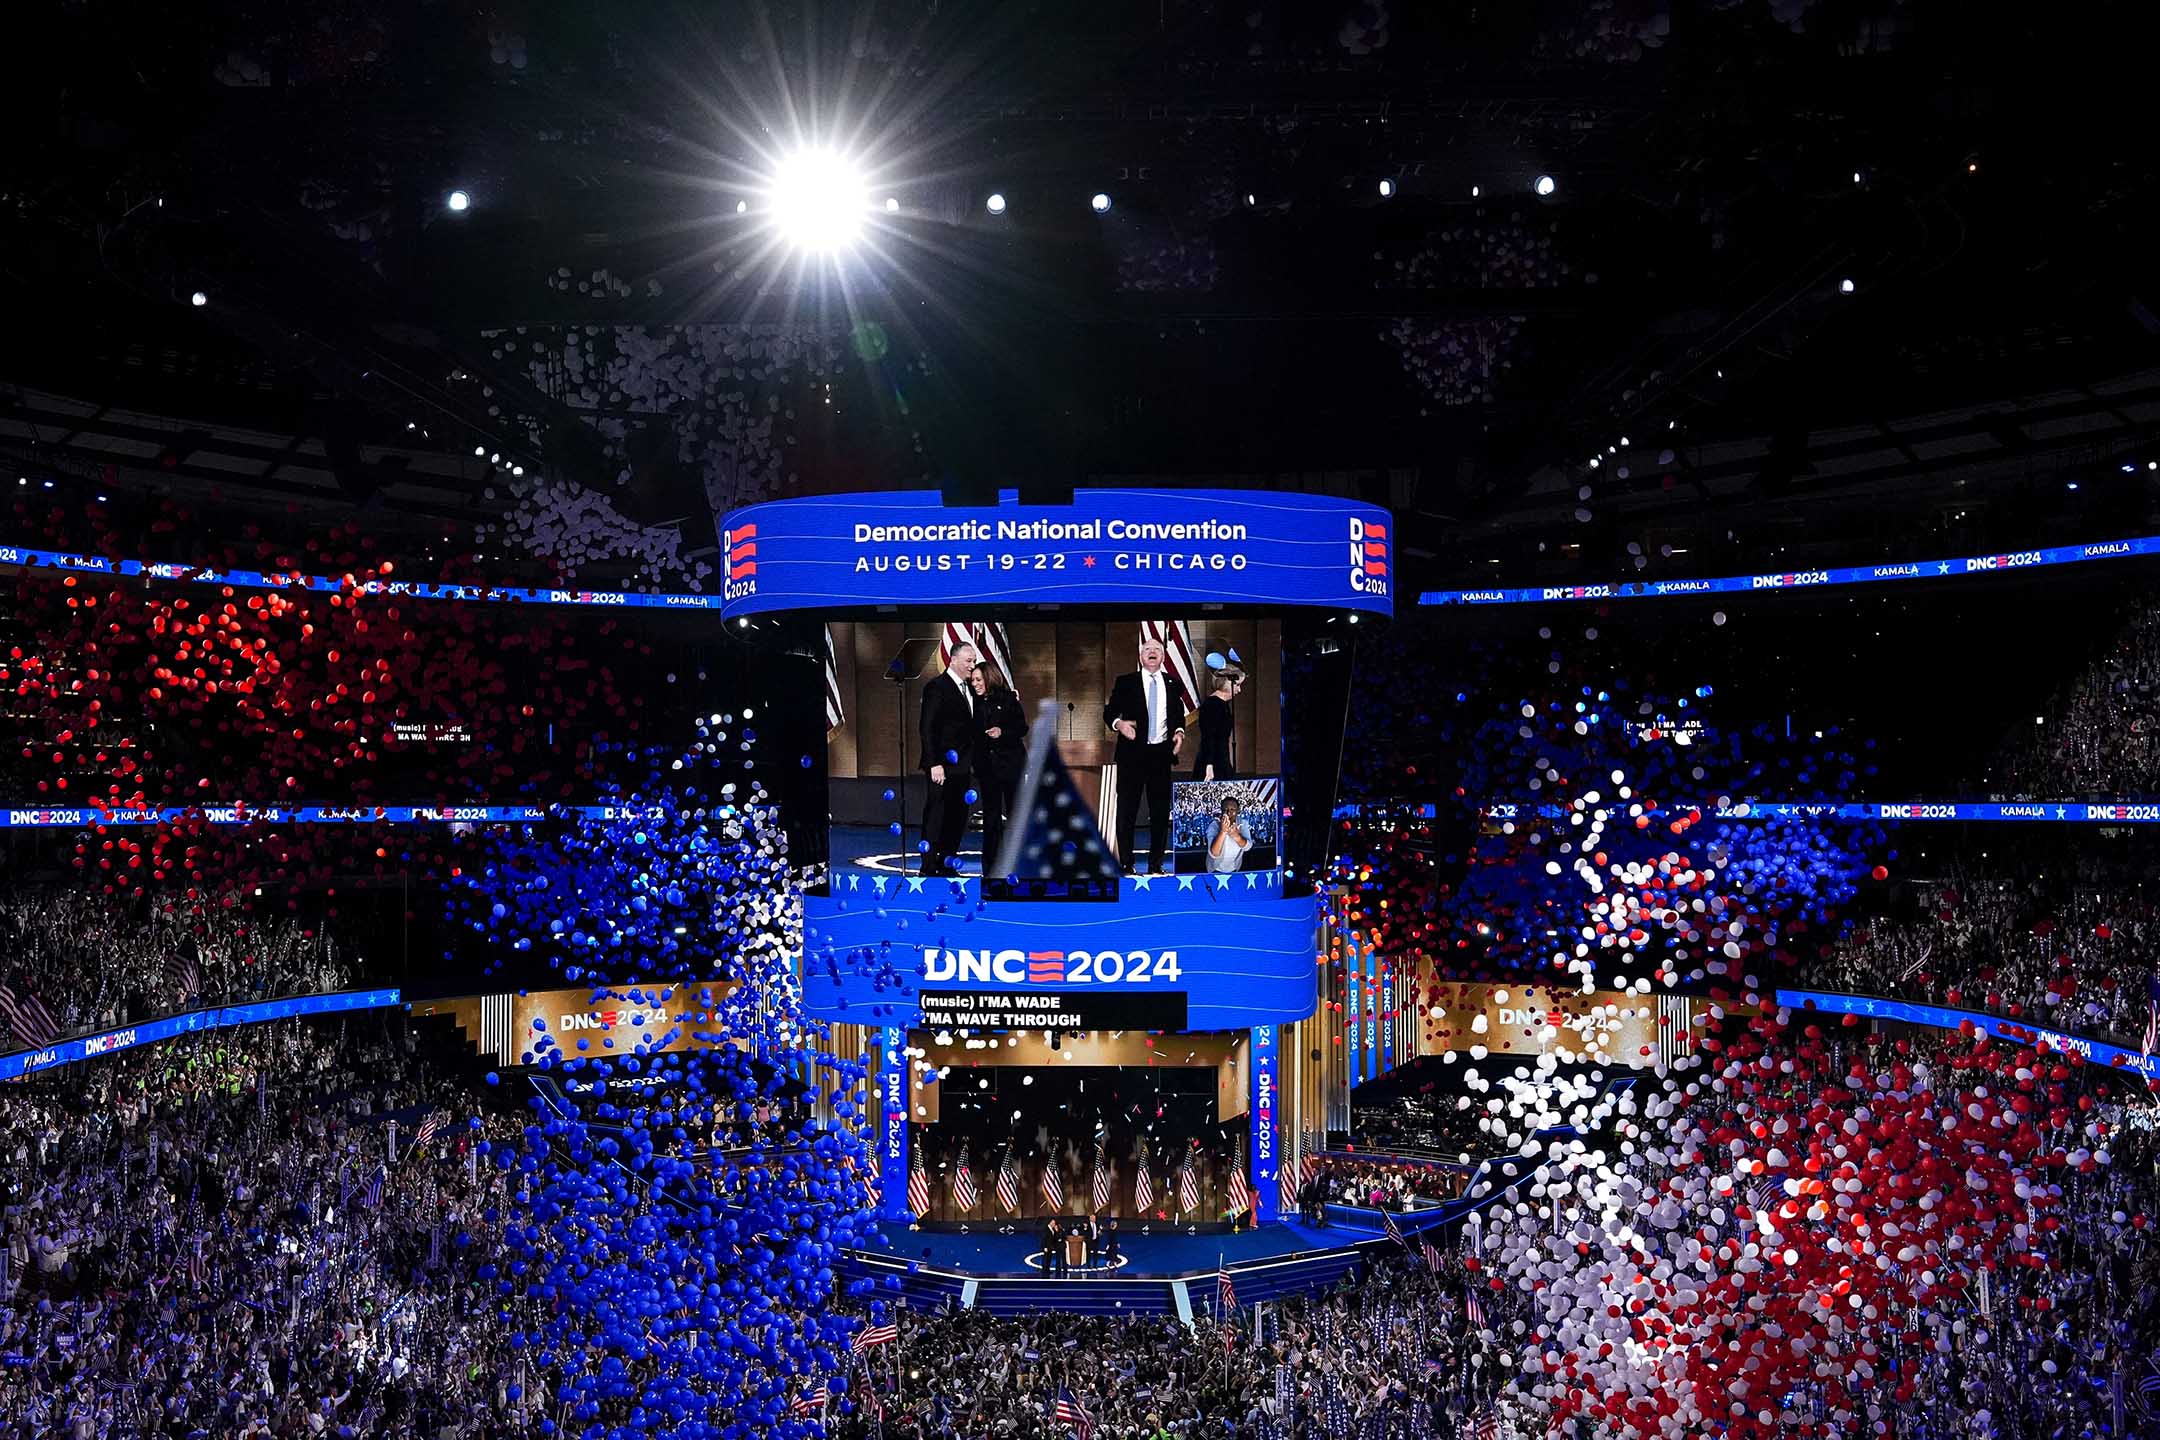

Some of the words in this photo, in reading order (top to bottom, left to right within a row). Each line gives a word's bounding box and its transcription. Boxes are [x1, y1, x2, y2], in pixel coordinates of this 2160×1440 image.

[855, 520, 991, 542] Democratic
[997, 519, 1100, 540] National
[1107, 519, 1247, 540] Convention
[855, 554, 970, 572] AUGUST
[987, 553, 1065, 570] 19-22
[1114, 553, 1247, 570] CHICAGO
[1350, 517, 1364, 591] DNC
[1365, 577, 1387, 596] 2024
[0, 548, 17, 561] 24
[60, 556, 104, 569] KMALA
[592, 593, 624, 604] 2024
[667, 596, 708, 606] KAMALA
[1462, 592, 1504, 601] KAMALA
[1584, 585, 1616, 597] 202
[1667, 582, 1710, 591] KAMALA
[1753, 575, 1783, 588] DNC
[1794, 572, 1828, 584] 2024
[1874, 565, 1919, 577] KAMALA
[1967, 556, 1997, 571] DNC
[2007, 552, 2041, 566] 2024
[2085, 543, 2130, 556] KAMALA
[731, 580, 756, 598] 2024
[10, 811, 39, 824] DNC
[49, 810, 81, 823] 2024
[454, 808, 488, 819] 2024
[1881, 805, 1911, 817] DNC
[1921, 805, 1956, 817] 2024
[2001, 806, 2045, 816] KAMALA
[2087, 806, 2116, 819] DNC
[2126, 806, 2159, 819] 2024
[924, 949, 1025, 982] DNC
[1066, 951, 1182, 982] 2024
[921, 995, 975, 1010] (music)
[979, 996, 1012, 1008] I'MA
[1015, 996, 1060, 1008] WADE
[560, 1012, 602, 1031] DNC
[956, 1013, 1000, 1025] WAVE
[1004, 1013, 1081, 1026] THROUGH
[1562, 1012, 1608, 1031] 224
[85, 1036, 107, 1055] DNC
[113, 1029, 136, 1047] 2024
[1350, 1023, 1358, 1050] 2024
[1259, 1073, 1270, 1109] DNC
[1259, 1120, 1270, 1160] 2024
